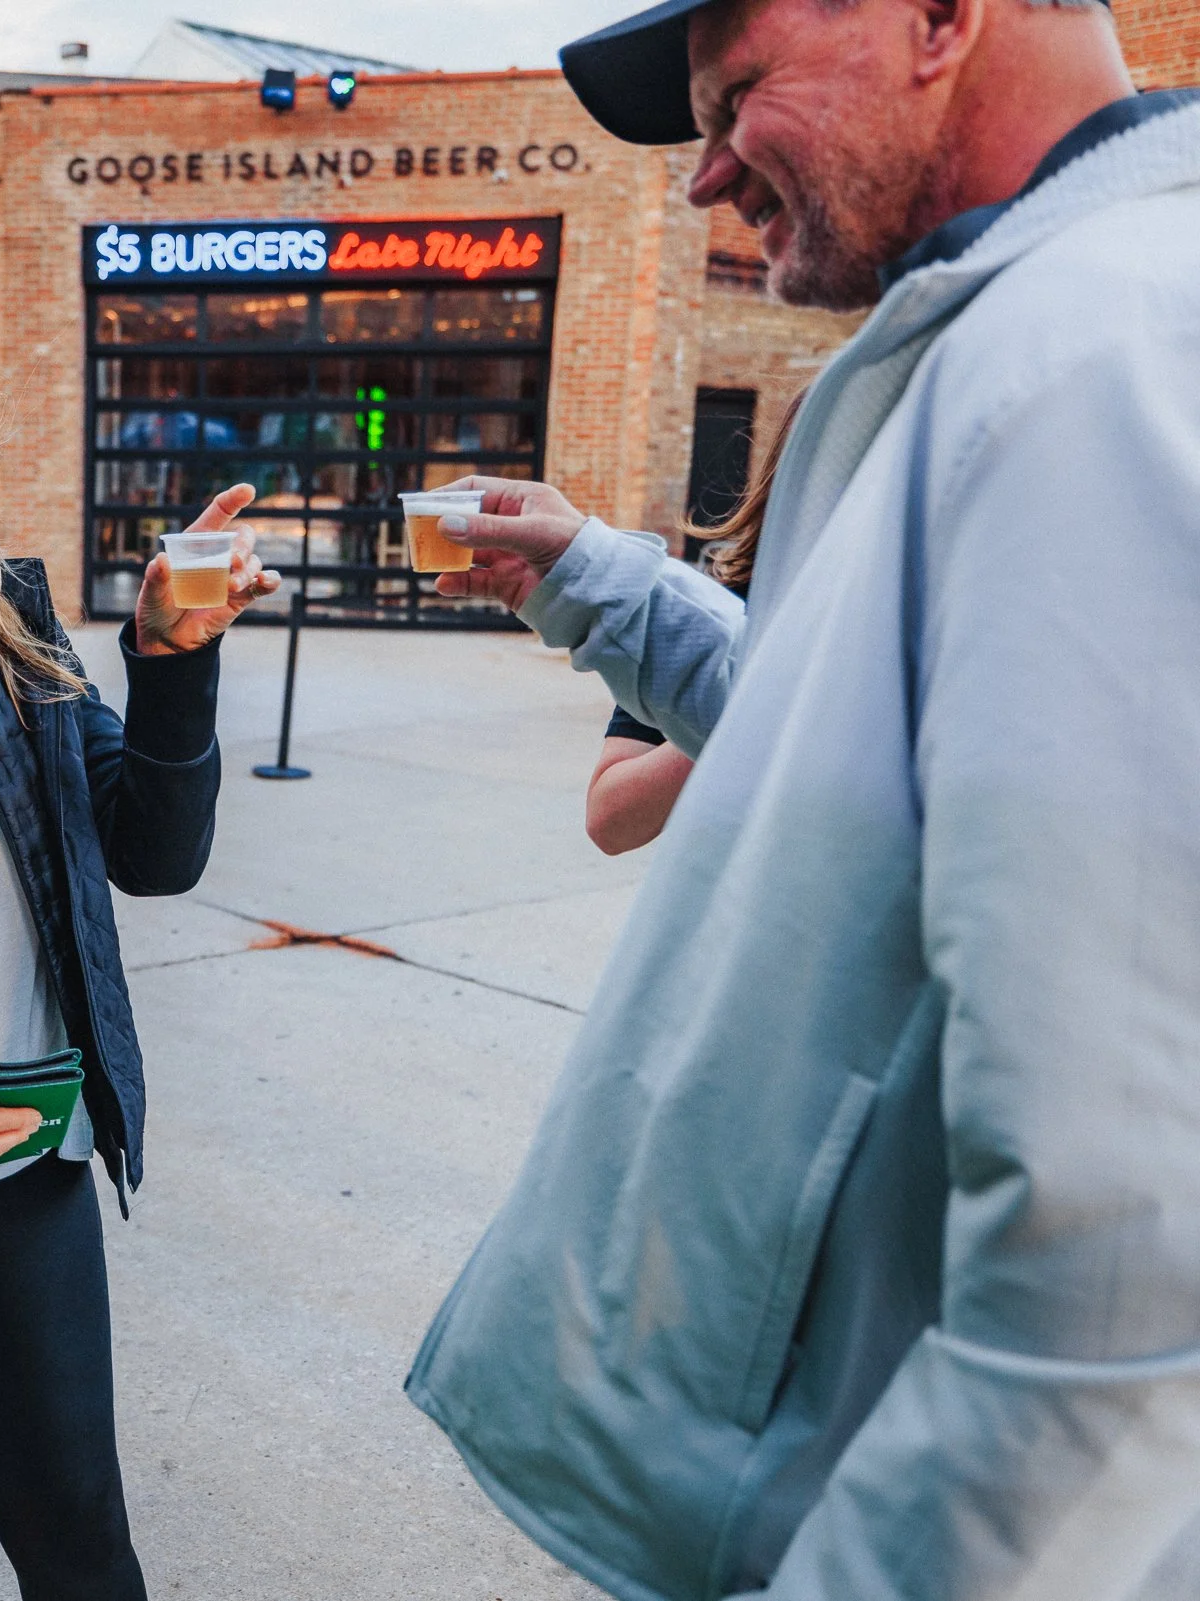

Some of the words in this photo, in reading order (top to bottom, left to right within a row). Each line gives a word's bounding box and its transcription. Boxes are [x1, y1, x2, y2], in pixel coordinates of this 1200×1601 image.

[67, 153, 204, 185] GOOSE
[222, 148, 375, 180] ISLAND
[394, 145, 499, 177] BEER
[518, 143, 591, 173] CO.
[96, 224, 141, 280] $5
[150, 229, 327, 272] BURGERS
[328, 232, 420, 269] Late
[423, 226, 544, 279] Night
